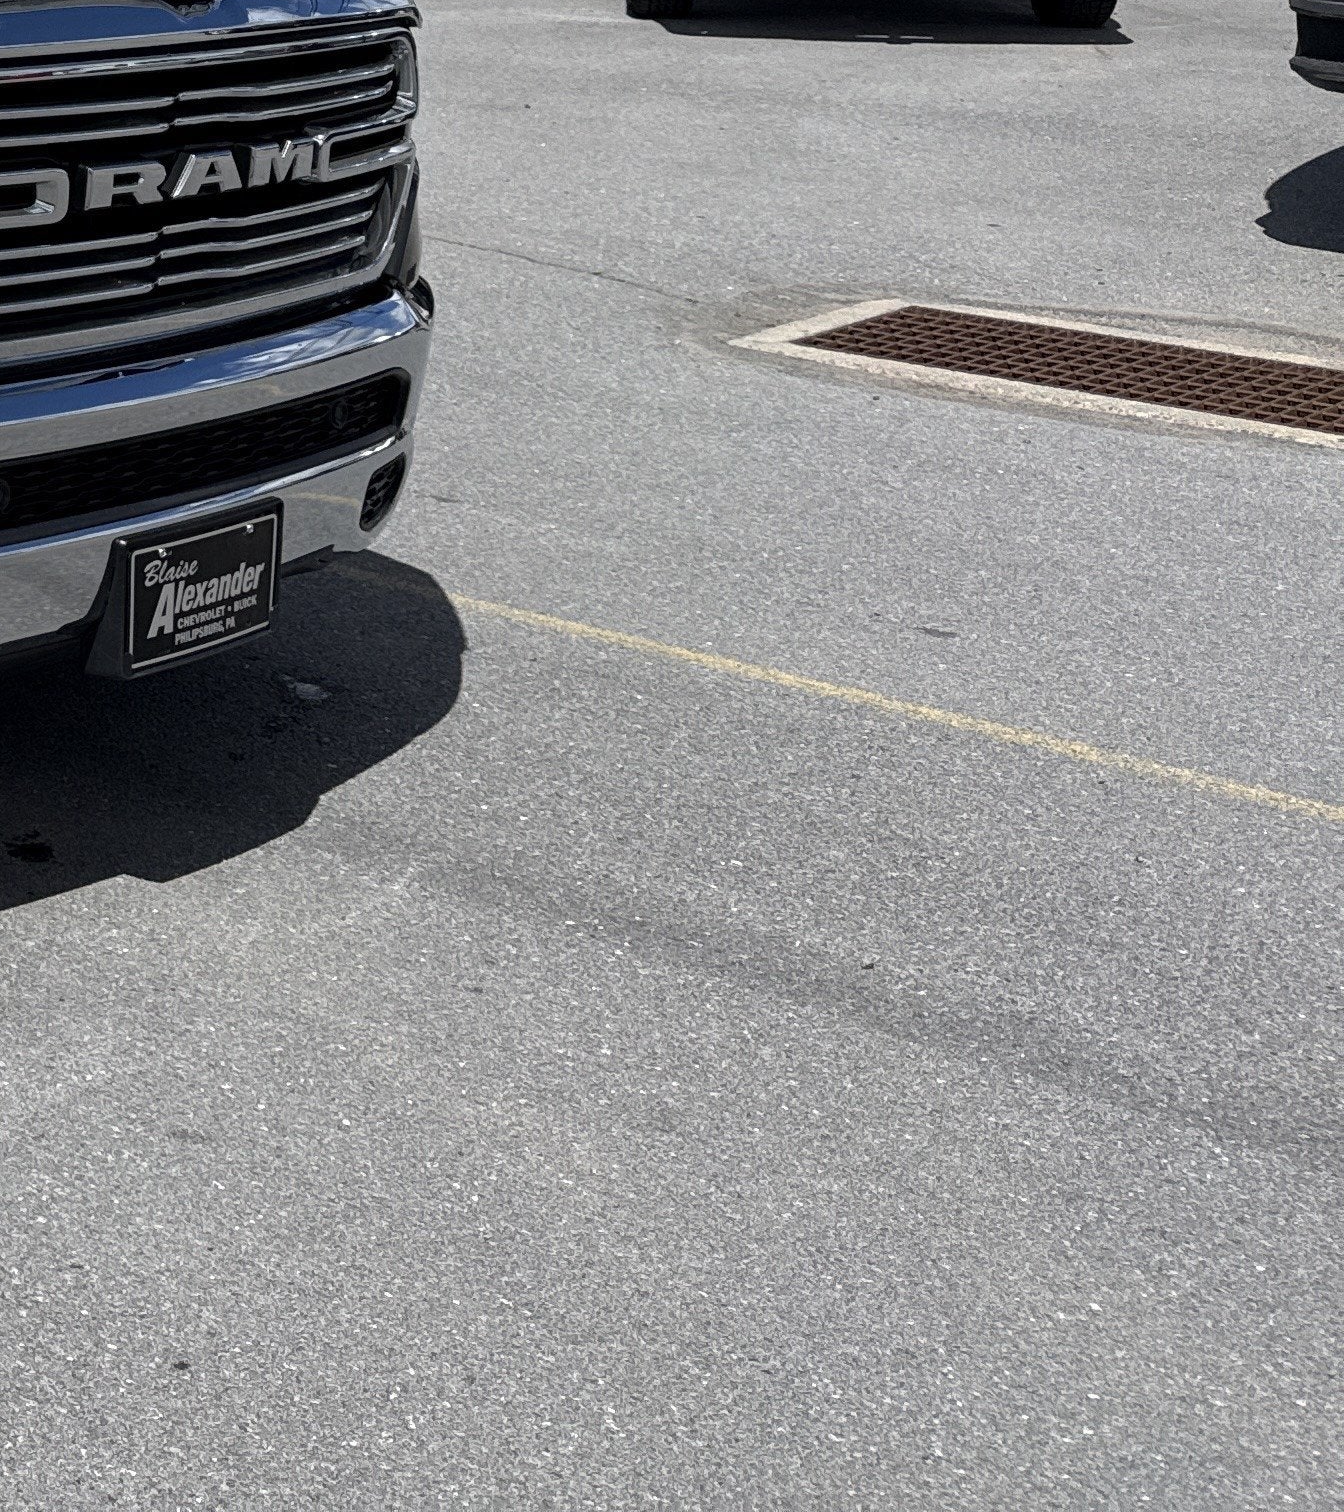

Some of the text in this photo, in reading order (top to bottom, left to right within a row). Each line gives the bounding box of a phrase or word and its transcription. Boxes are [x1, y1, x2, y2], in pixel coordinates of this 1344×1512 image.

[78, 139, 314, 211] RAM
[143, 559, 200, 587] Blaise
[146, 561, 266, 639] Alexander
[177, 604, 226, 630] CHEVROLET
